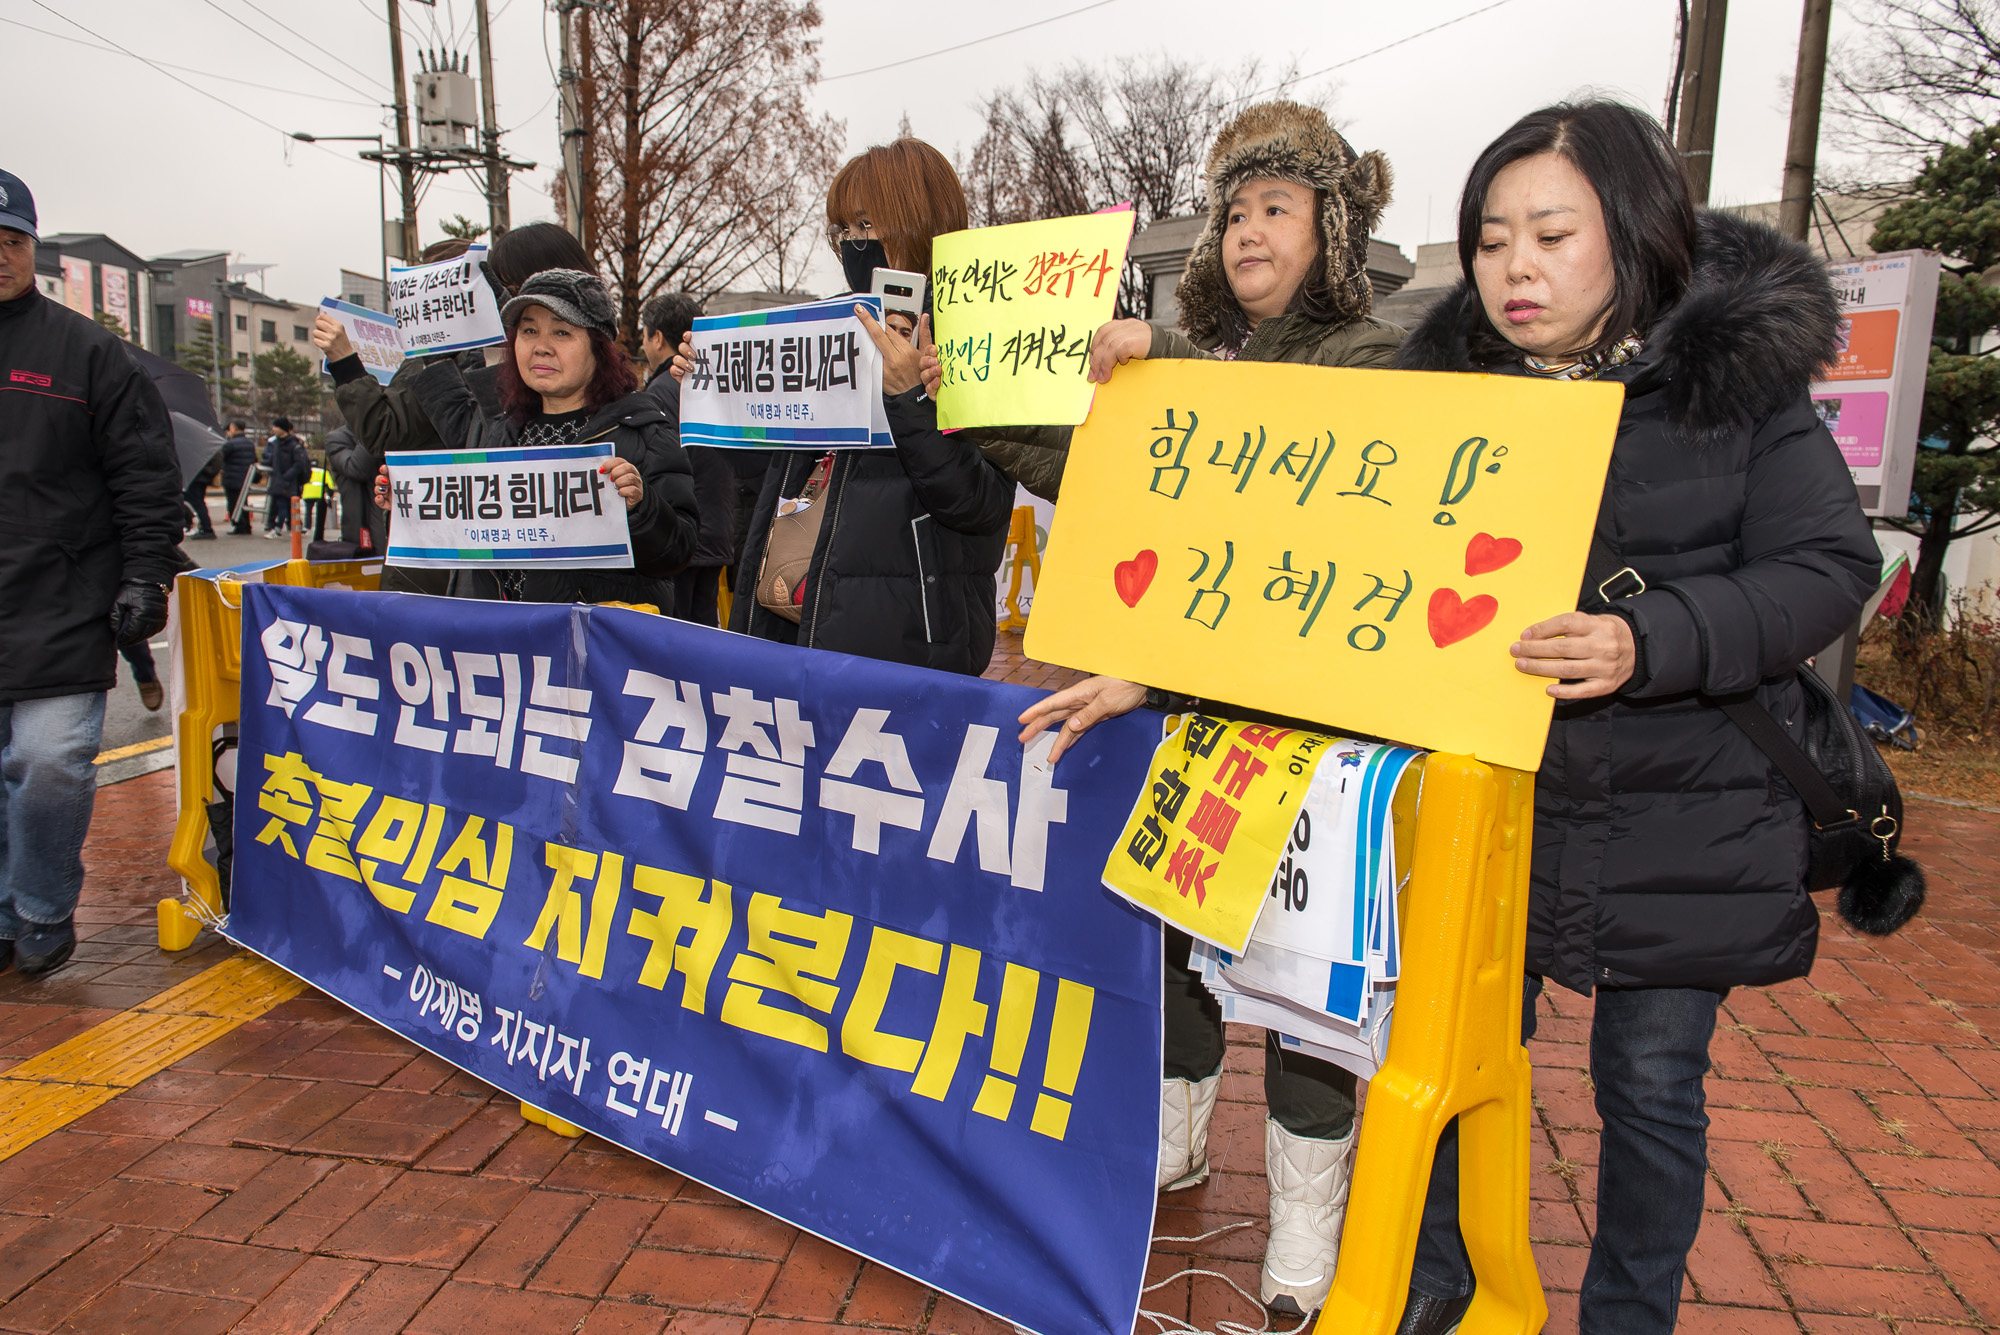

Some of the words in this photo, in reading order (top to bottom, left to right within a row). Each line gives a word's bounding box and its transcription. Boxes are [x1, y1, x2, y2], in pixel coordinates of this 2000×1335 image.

[387, 276, 418, 301] 이없는
[392, 302, 419, 330] 정수사
[422, 290, 476, 323] 촉구한다!
[780, 331, 860, 393] 힘내라
[507, 469, 605, 519] 힘내라
[1149, 408, 1399, 507] 힘내세요
[1184, 541, 1413, 652] 김혜경
[389, 642, 593, 784] 안되는
[612, 668, 1068, 893] 검찰수사
[255, 751, 514, 940] 촛불민심
[523, 841, 1095, 1142] 지켜본다!!
[409, 963, 483, 1042] 이재명
[490, 1006, 592, 1096] 지지자
[605, 1050, 694, 1136] 연대
